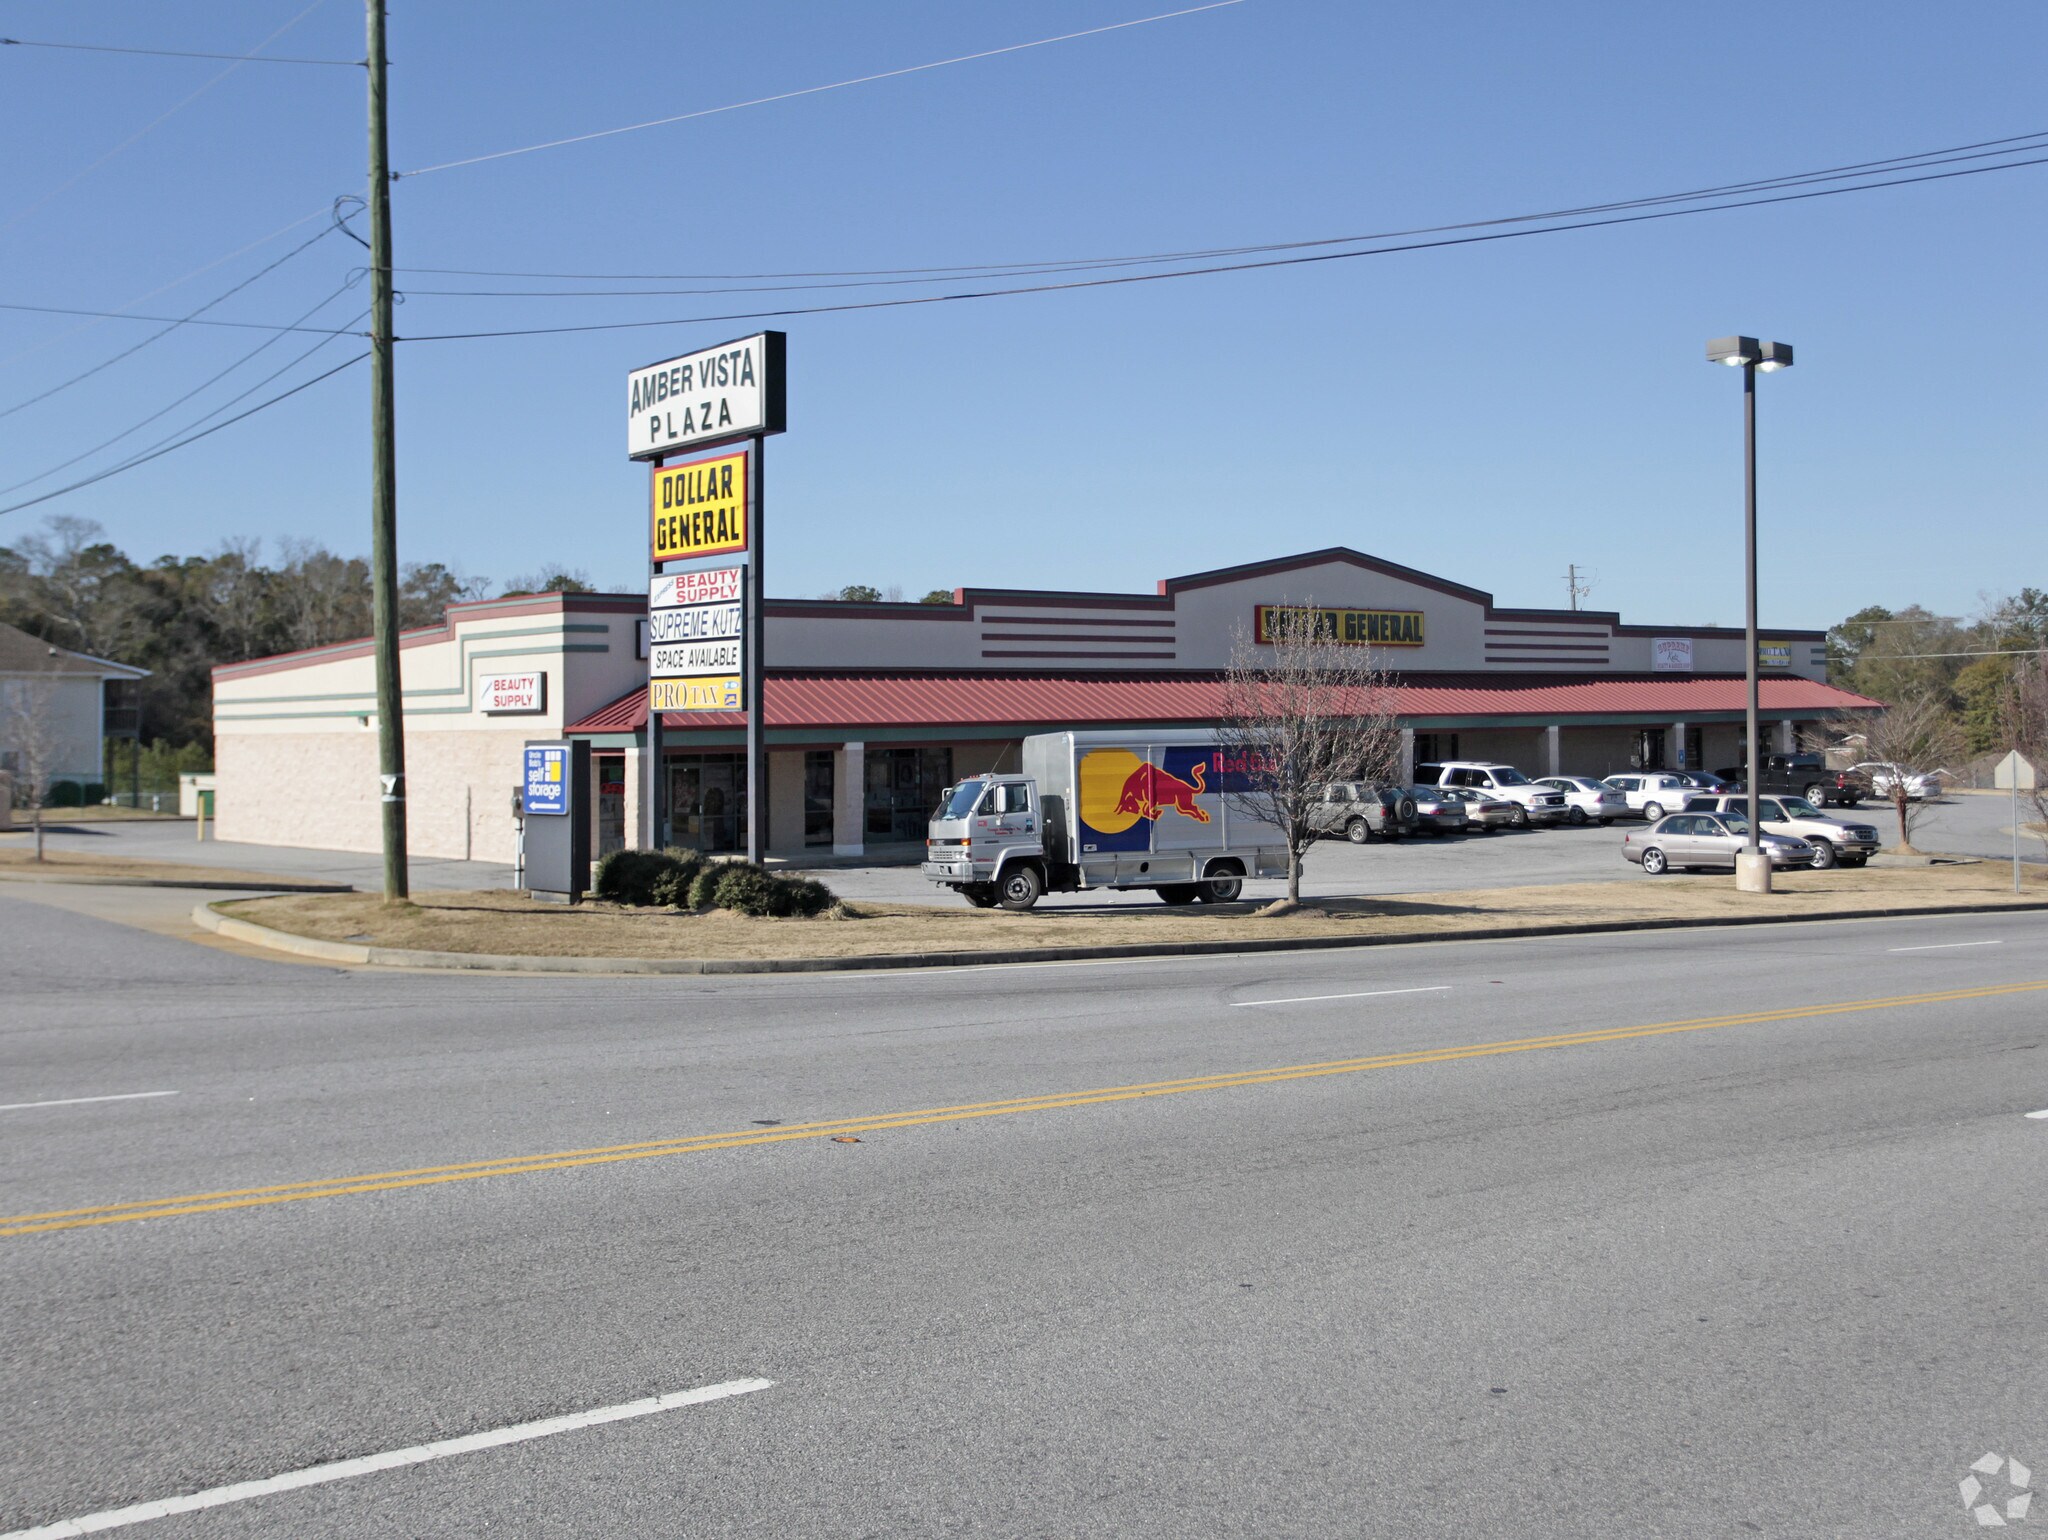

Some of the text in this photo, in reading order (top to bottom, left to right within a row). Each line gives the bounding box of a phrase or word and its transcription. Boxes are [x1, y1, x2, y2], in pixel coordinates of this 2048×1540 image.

[631, 347, 755, 418] AMBER VISTA
[650, 398, 732, 443] PLAZA
[663, 464, 733, 510] DOLLAR
[657, 506, 739, 551] GENERAL
[676, 569, 738, 589] BEAUTY
[676, 585, 737, 603] SUPPLY
[651, 607, 741, 640] SUPREME KUTZ
[1345, 612, 1423, 642] GENERAL
[656, 647, 737, 669] SPACE AVAILABLE
[494, 678, 534, 691] BEAUTY
[653, 682, 718, 709] PRO TAX
[494, 694, 533, 707] SUPPLY
[1213, 751, 1283, 773] Red Bu
[528, 767, 544, 782] self
[528, 782, 561, 800] storage
